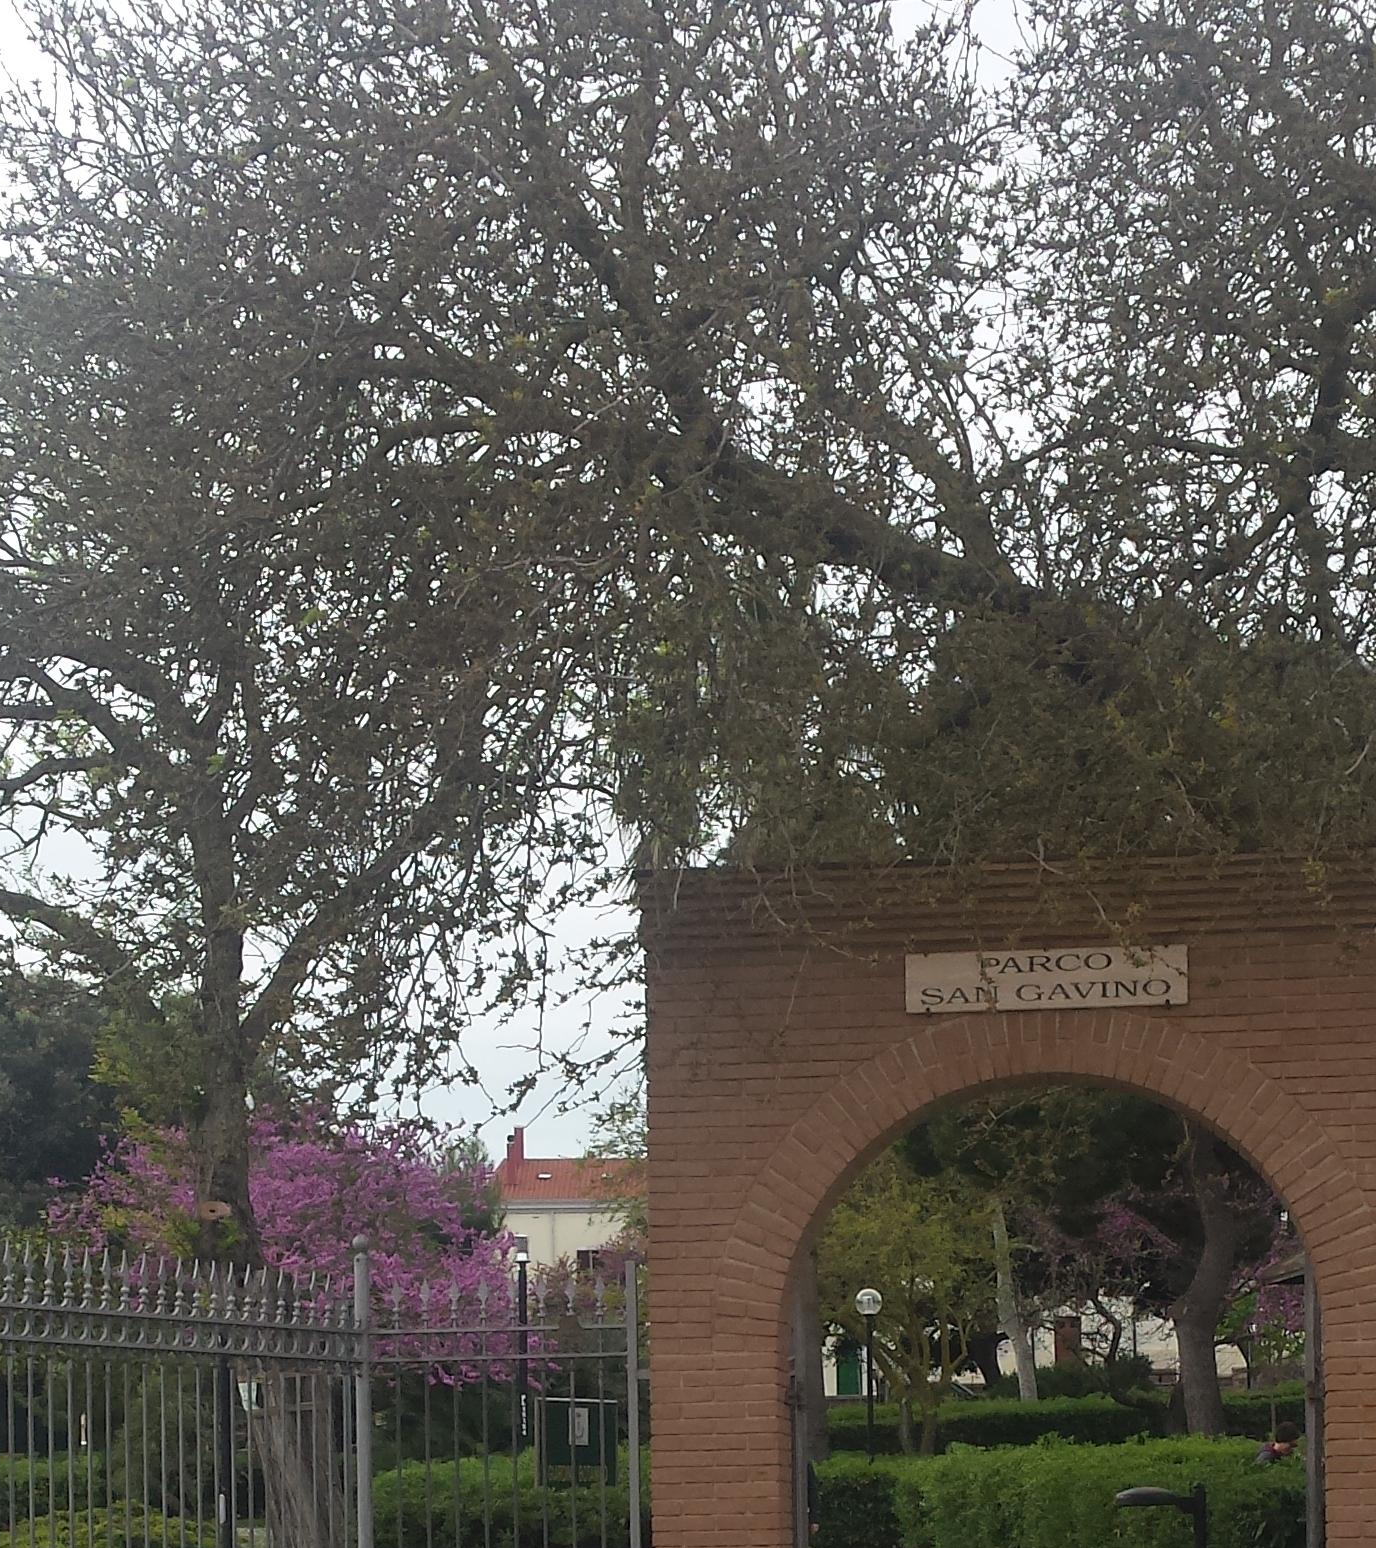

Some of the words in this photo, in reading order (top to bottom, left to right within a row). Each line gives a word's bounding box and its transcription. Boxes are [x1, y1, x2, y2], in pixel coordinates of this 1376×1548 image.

[980, 952, 1112, 975] PARCO
[920, 985, 999, 1006] SAN
[1015, 978, 1172, 1001] GAVINO
